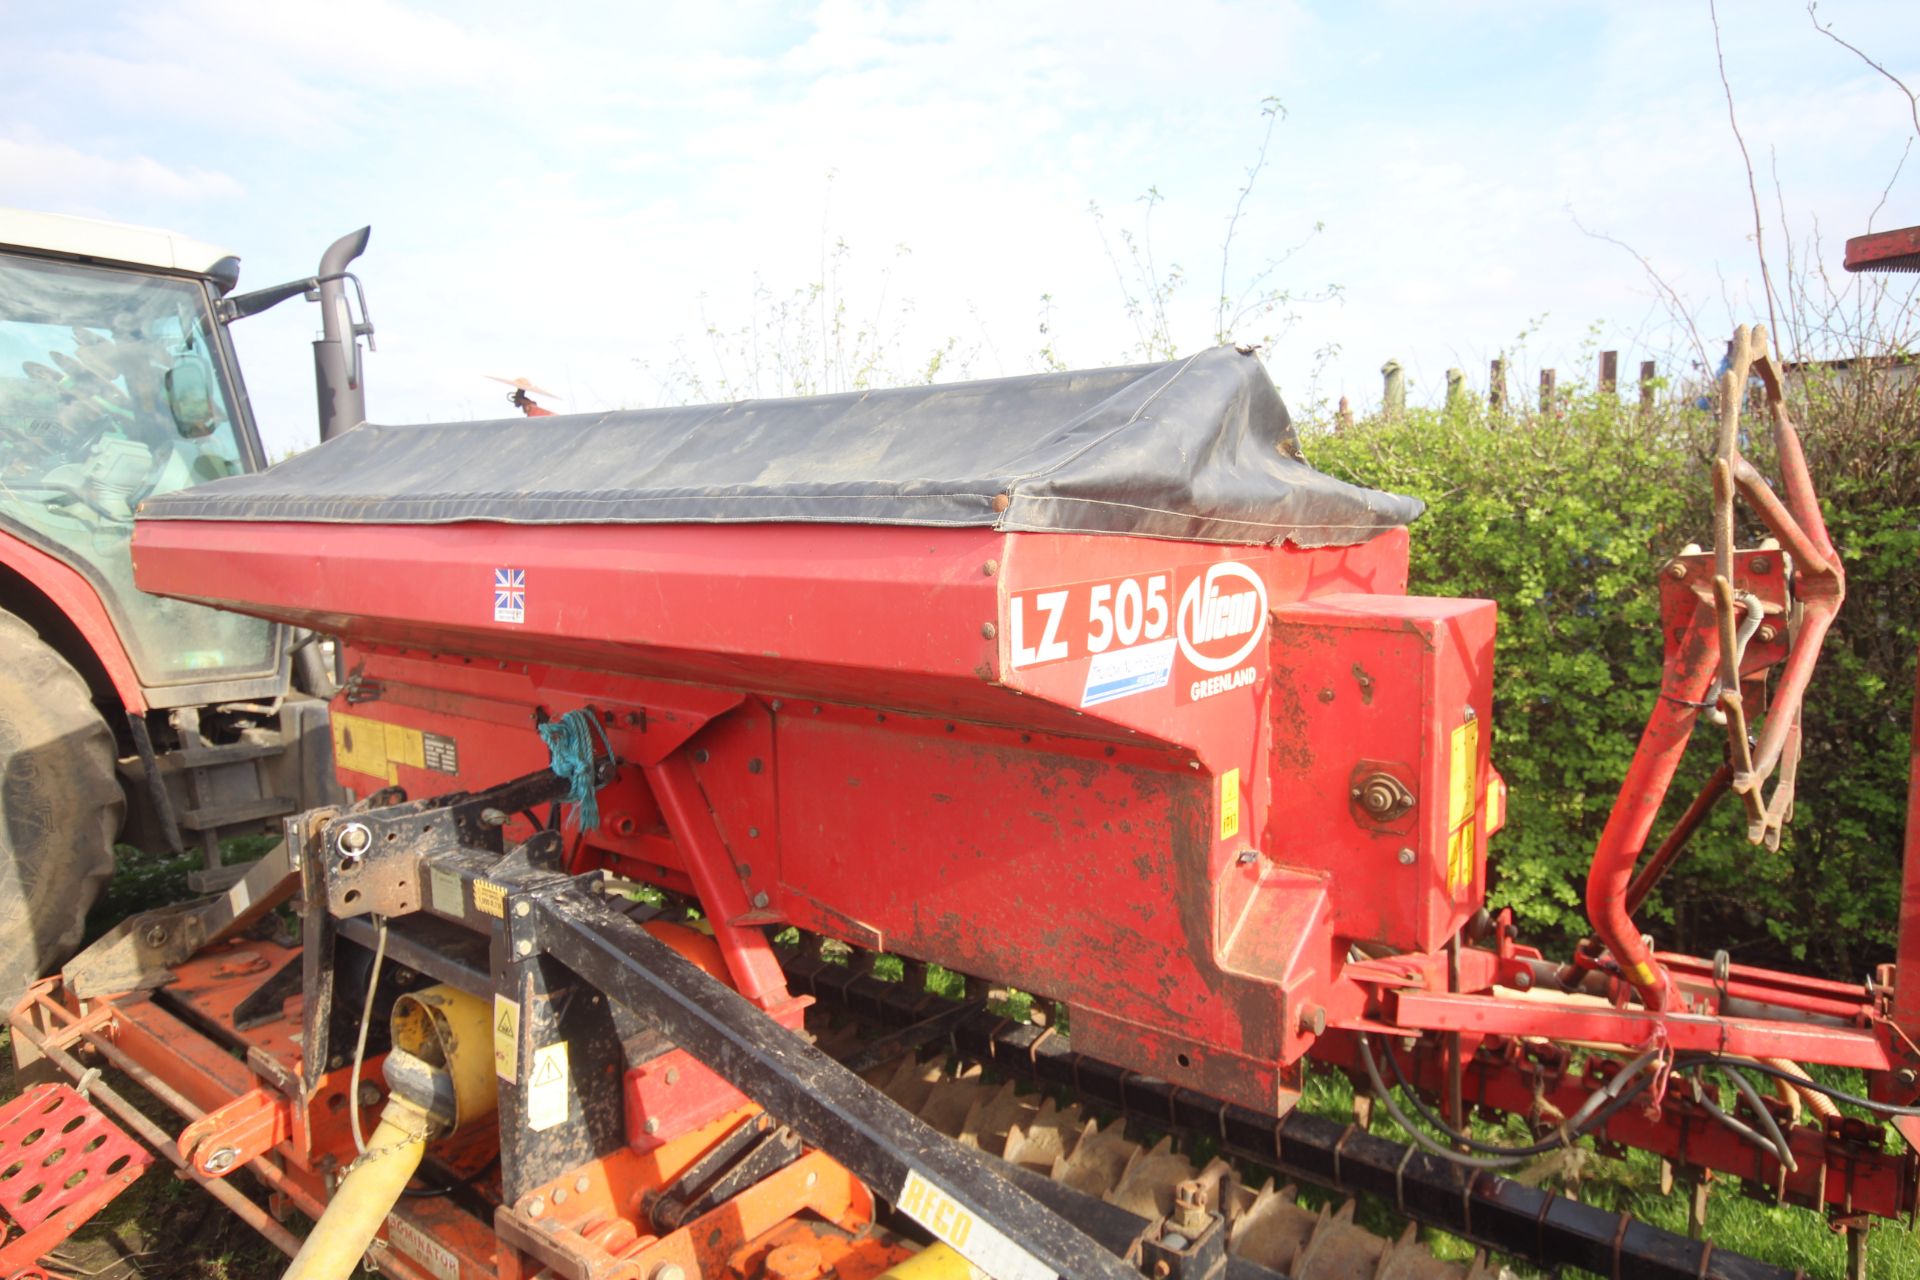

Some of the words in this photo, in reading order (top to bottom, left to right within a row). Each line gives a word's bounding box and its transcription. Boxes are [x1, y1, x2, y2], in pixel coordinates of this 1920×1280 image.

[1010, 590, 1068, 668] LZ
[1087, 575, 1169, 653] 505
[1188, 570, 1258, 647] Vicon
[1190, 666, 1256, 701] GREENLAND
[903, 1178, 973, 1249] RECO
